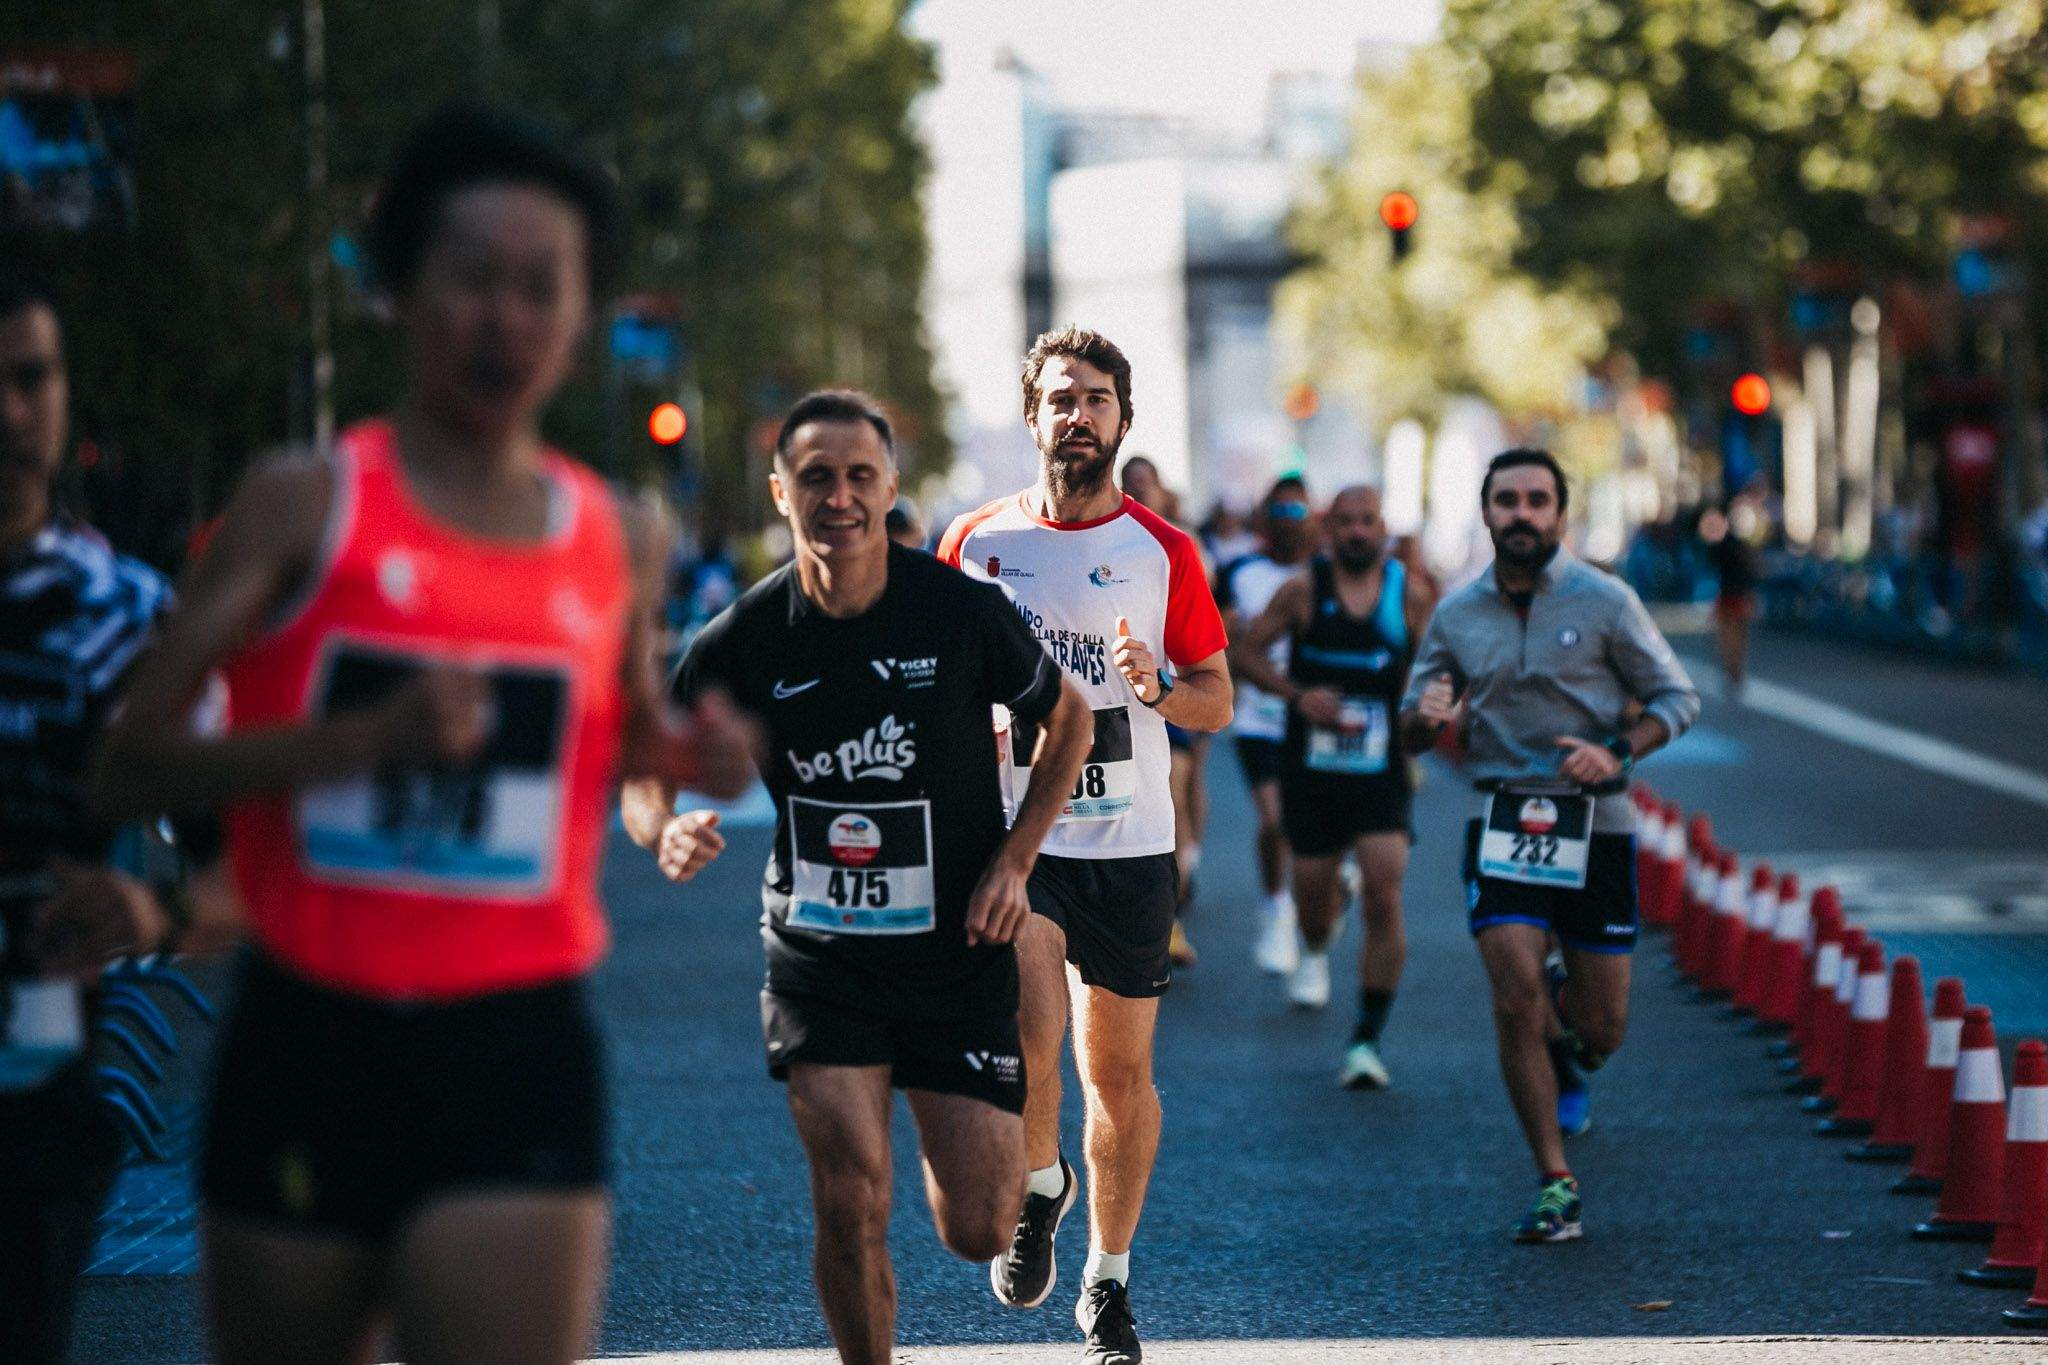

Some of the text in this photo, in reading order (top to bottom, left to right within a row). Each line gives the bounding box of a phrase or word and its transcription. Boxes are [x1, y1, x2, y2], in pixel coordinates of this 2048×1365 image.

[1058, 630, 1070, 642] DE
[1071, 632, 1105, 646] OLALLA
[787, 727, 917, 783] be plus
[1510, 833, 1559, 866] 232
[828, 869, 890, 909] 475
